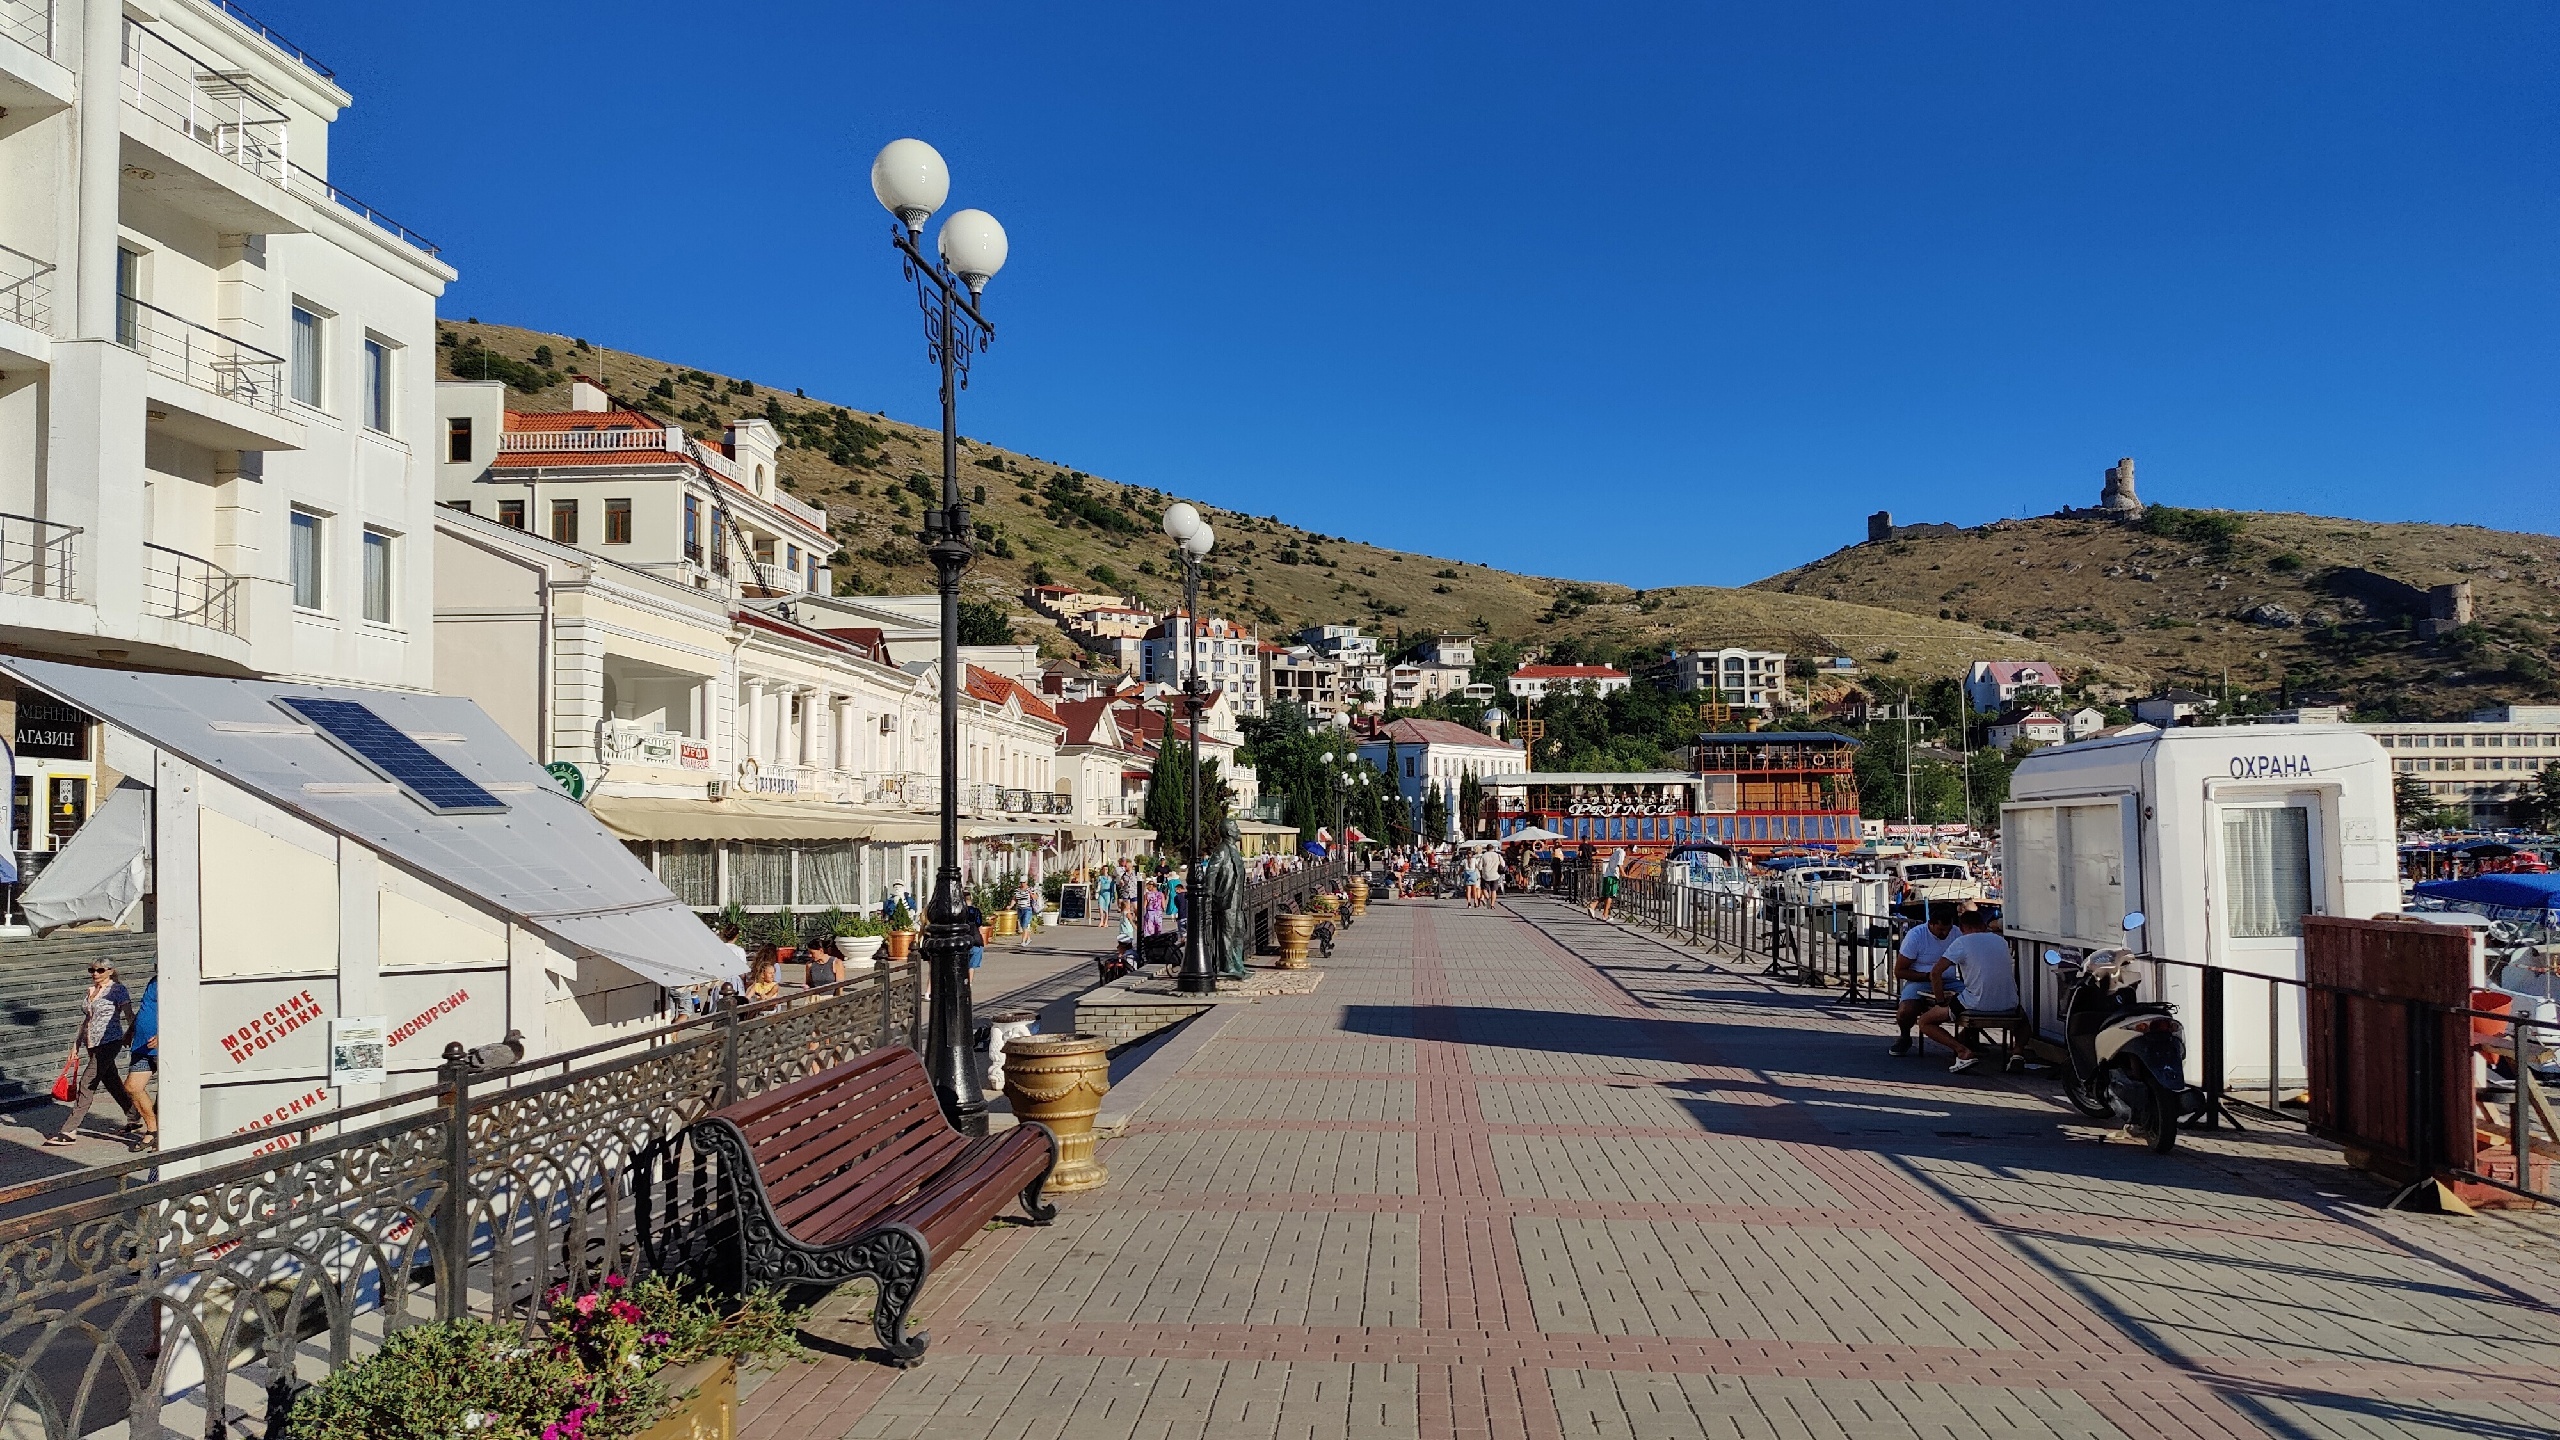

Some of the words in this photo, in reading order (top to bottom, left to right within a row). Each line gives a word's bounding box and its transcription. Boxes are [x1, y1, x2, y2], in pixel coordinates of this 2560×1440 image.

[2230, 754, 2313, 780] ОХРАНА
[1568, 803, 1677, 817] PRINCE
[220, 989, 315, 1052] МОРСКИЕ
[230, 1003, 324, 1064] ПРОГУЛКИ
[387, 988, 470, 1048] ЭКСКУРСИИ
